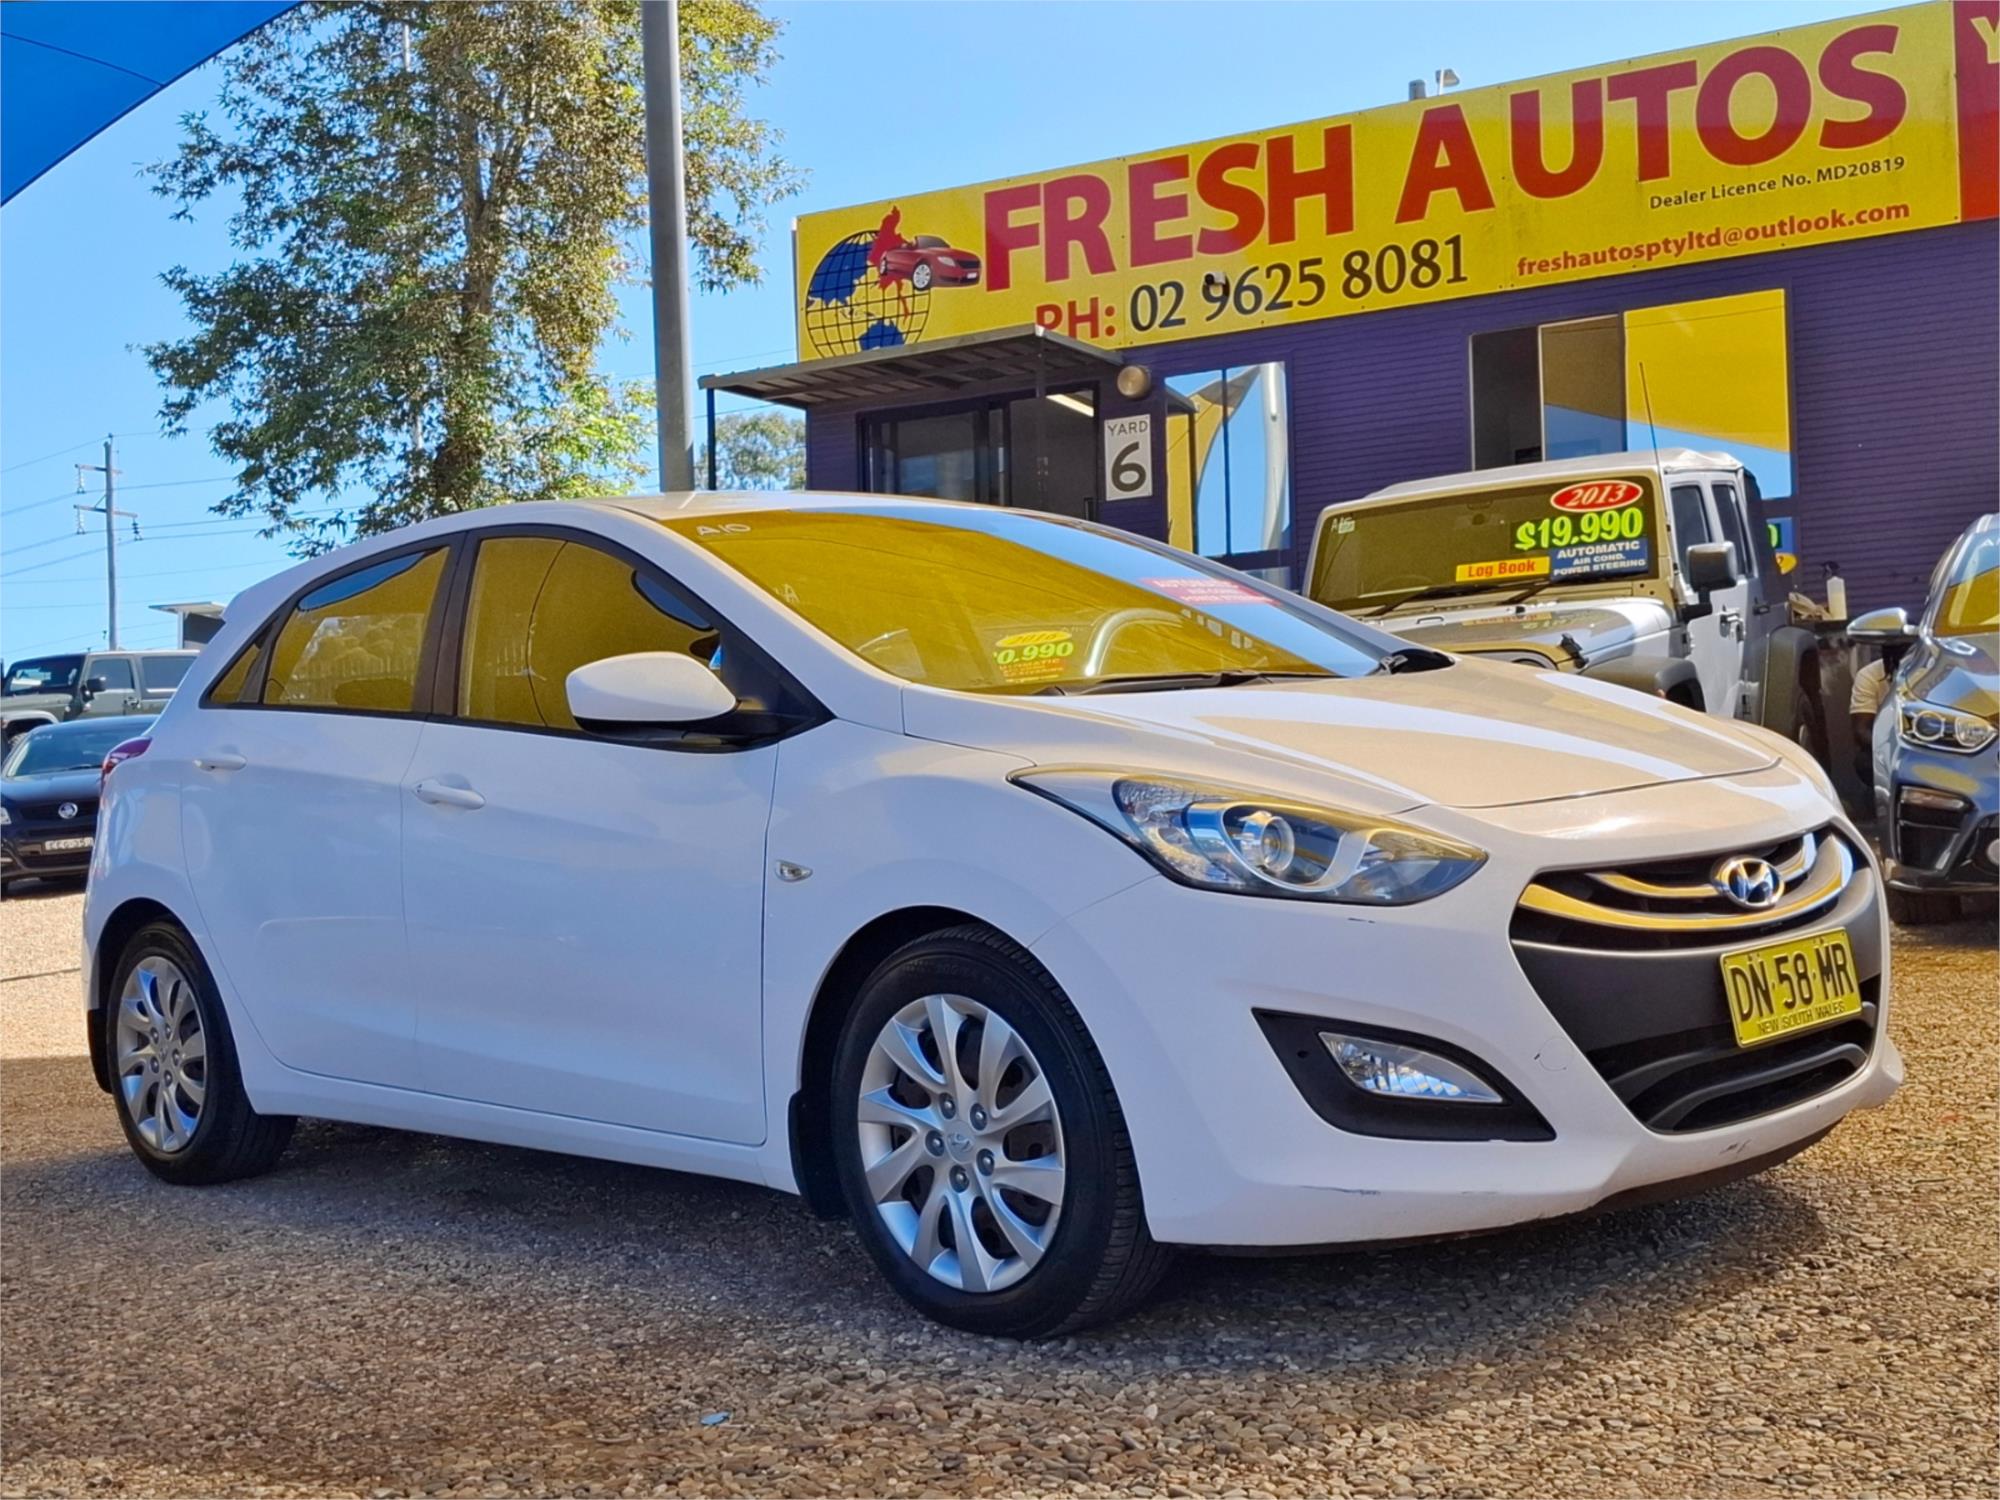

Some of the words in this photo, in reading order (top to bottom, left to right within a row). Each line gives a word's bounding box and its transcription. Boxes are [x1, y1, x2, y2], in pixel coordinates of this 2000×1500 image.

[984, 124, 1354, 292] FRESH
[1394, 24, 1907, 224] AUTOS
[1650, 190, 1706, 208] Dealer
[1711, 178, 1777, 199] Licence
[1782, 174, 1811, 188] No.
[1816, 156, 1906, 182] MD20819
[1517, 203, 1911, 276] freshautosptyltd@outlook.com
[1036, 297, 1115, 339] PH:
[1130, 281, 1187, 332] 02
[1202, 257, 1326, 322] 9625
[1341, 234, 1468, 299] 8081
[1107, 420, 1149, 437] YARD
[1110, 441, 1147, 492] 6
[1565, 484, 1628, 507] 2013
[1557, 540, 1640, 559] AUTOMATIC
[1573, 556, 1591, 566] AIR
[1467, 565, 1493, 578] Log
[1498, 559, 1536, 575] Book
[1553, 564, 1591, 576] POWER
[1592, 558, 1647, 571] STEERING
[1757, 1018, 1779, 1034] NEW
[1782, 1010, 1814, 1029] SOUTH
[1815, 1001, 1846, 1022] WALES
